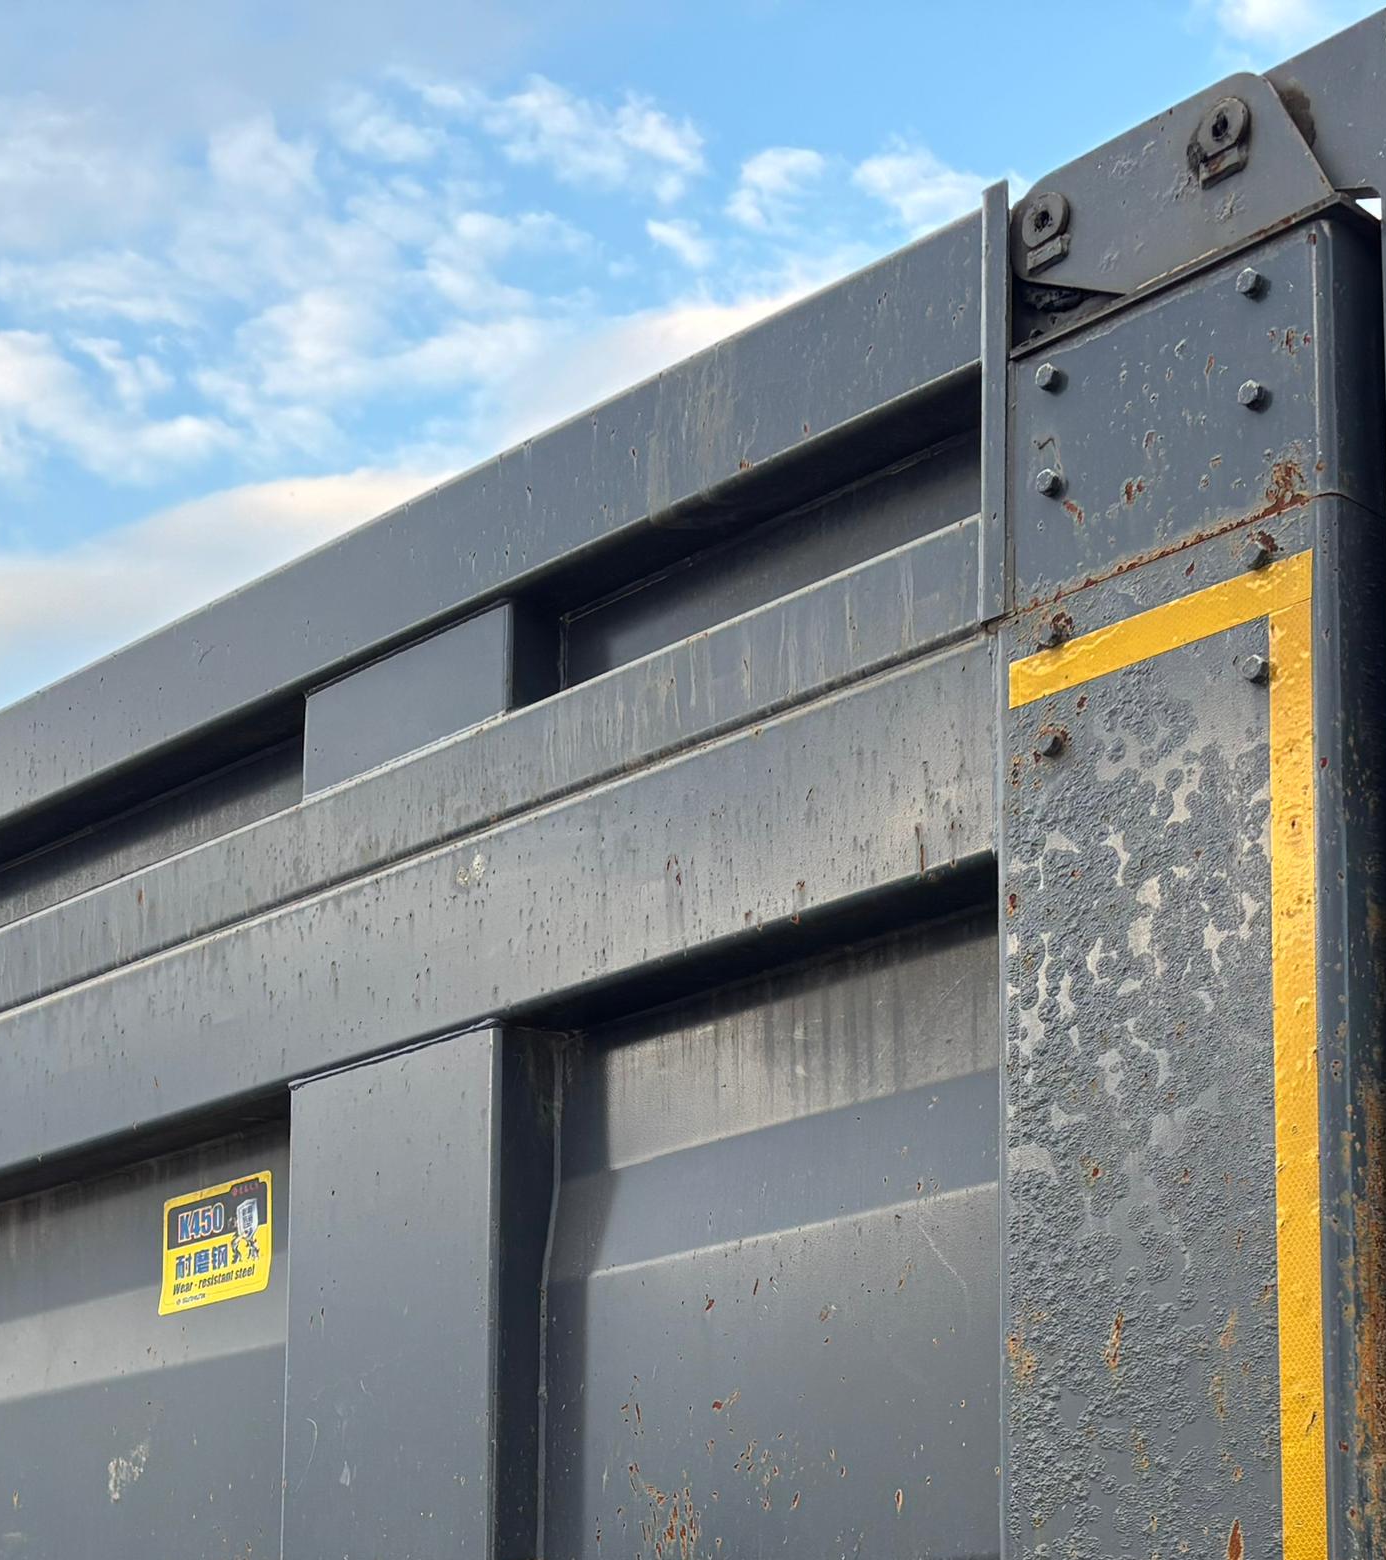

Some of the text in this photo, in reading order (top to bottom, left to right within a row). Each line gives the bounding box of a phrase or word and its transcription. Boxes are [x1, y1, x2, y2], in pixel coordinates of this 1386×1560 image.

[177, 1202, 225, 1243] K450
[175, 1244, 228, 1280] 耐磨钢
[234, 1264, 255, 1280] steel
